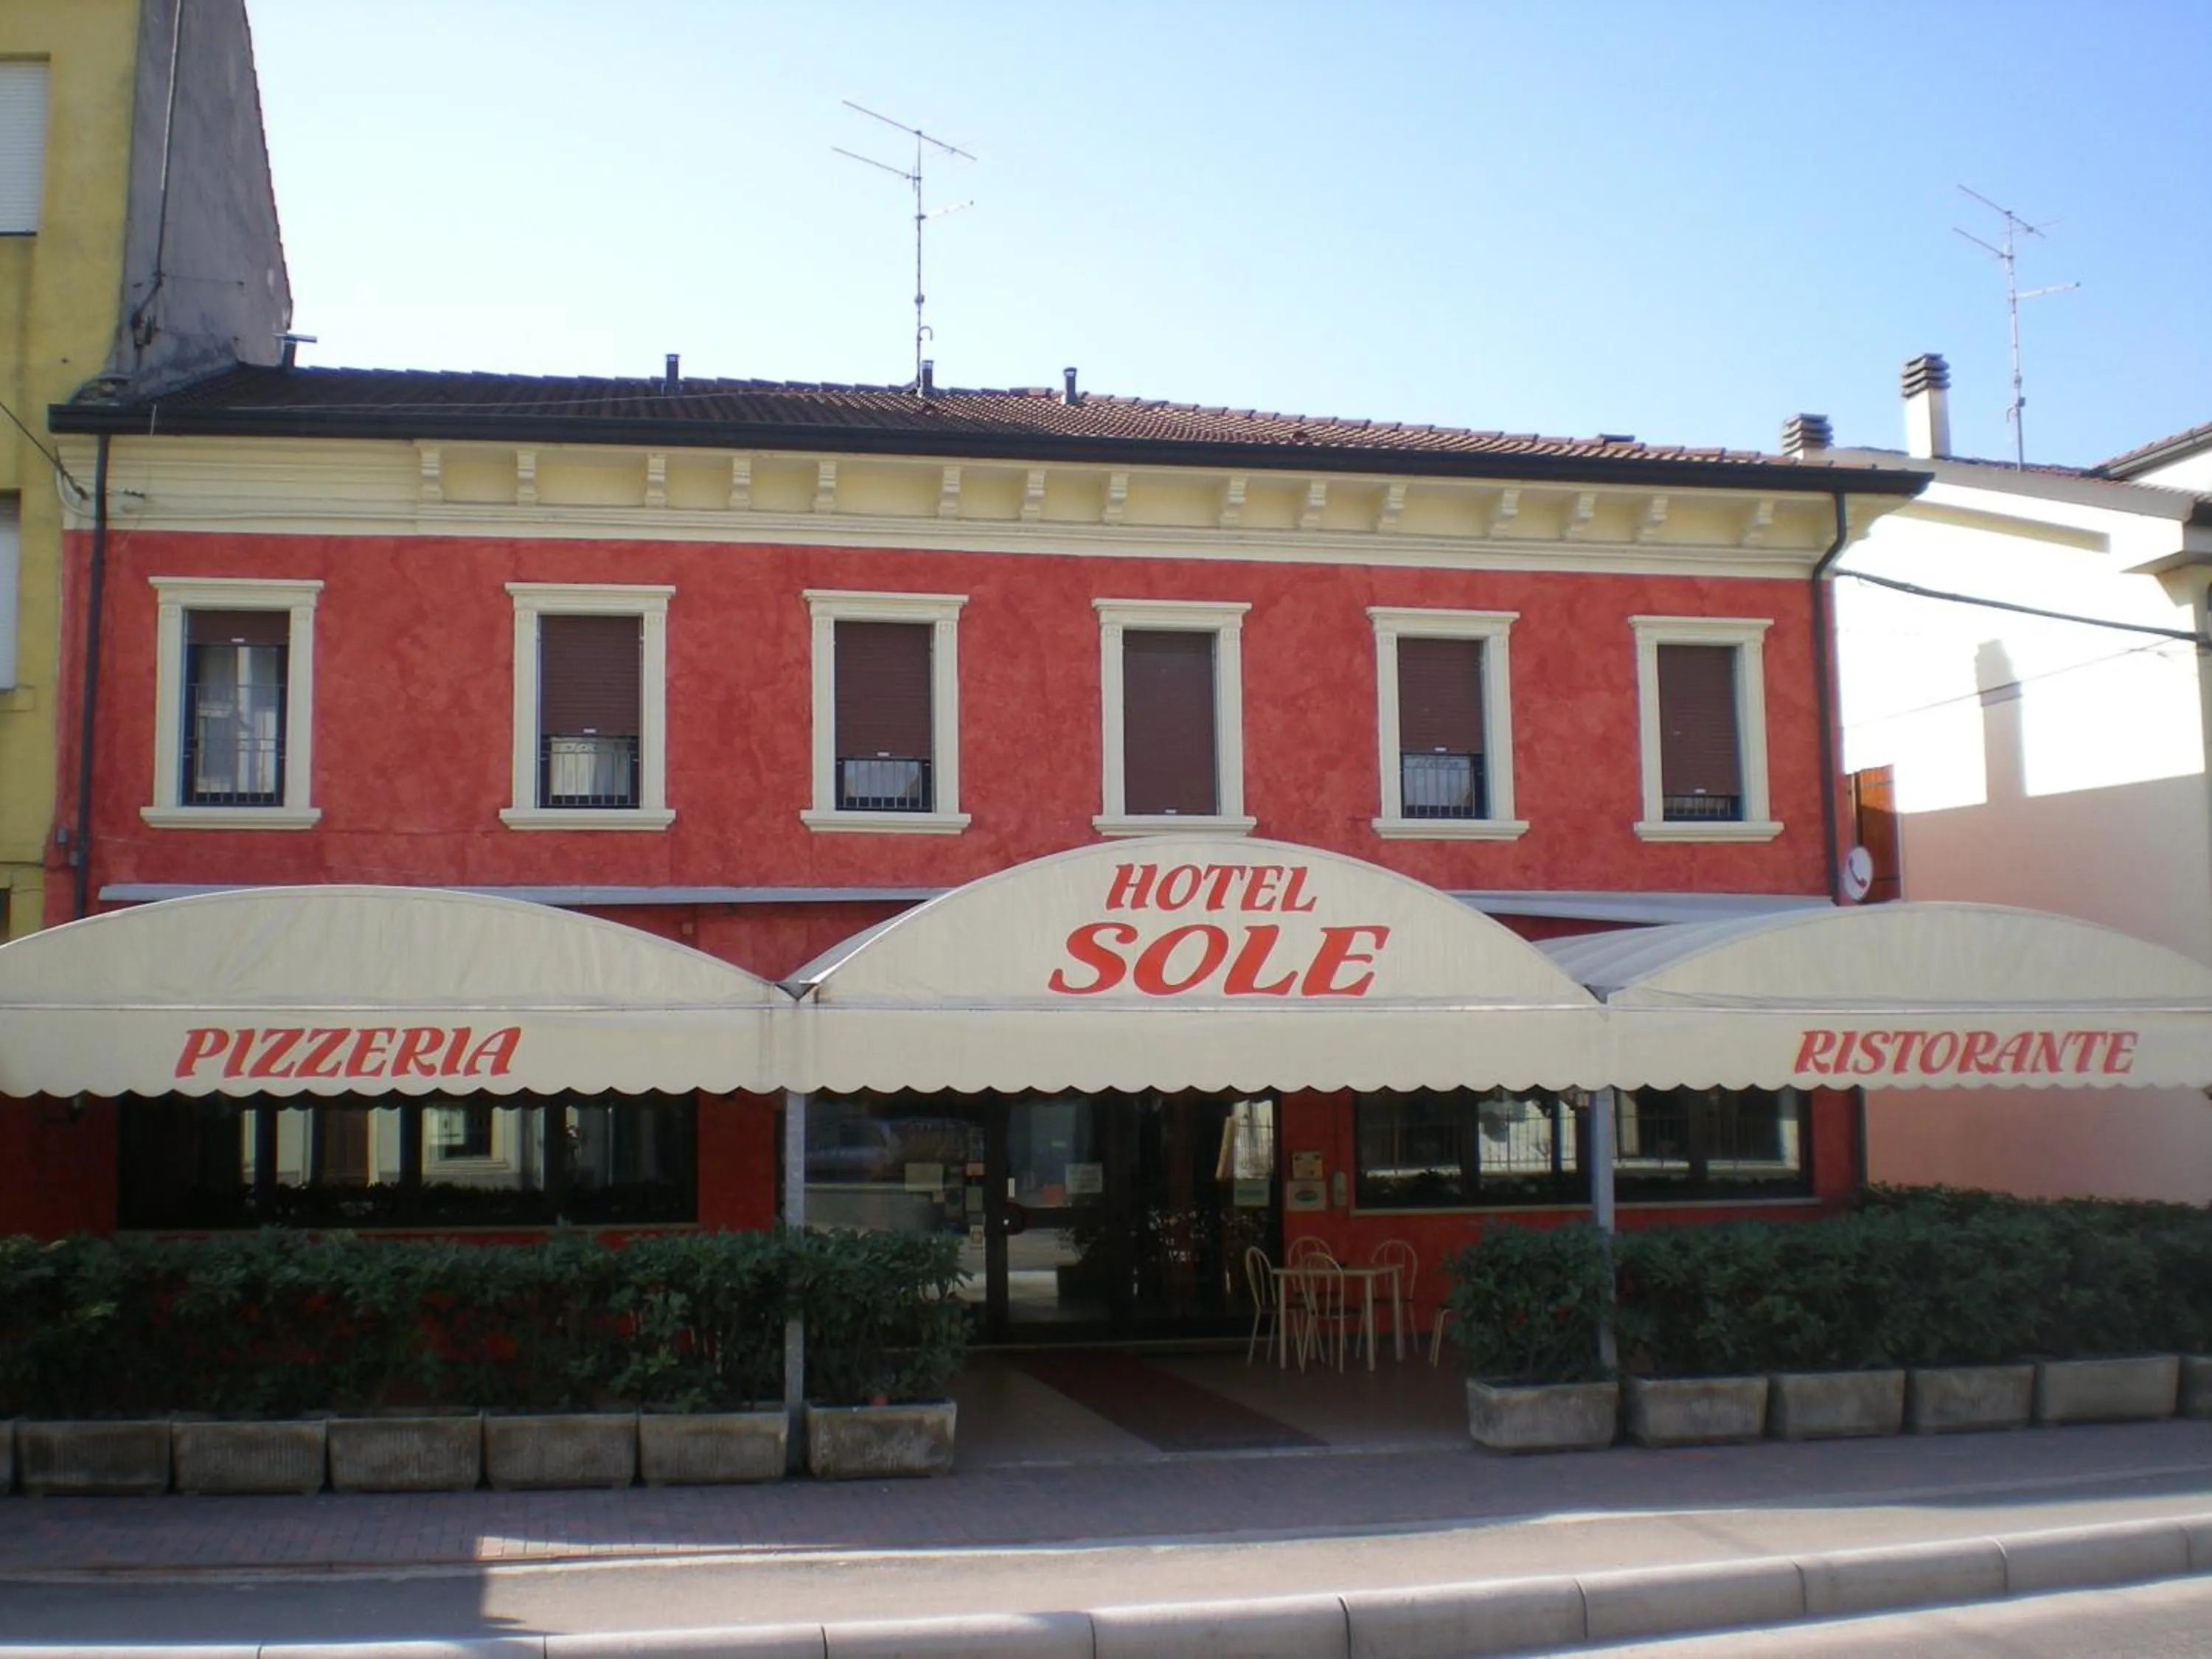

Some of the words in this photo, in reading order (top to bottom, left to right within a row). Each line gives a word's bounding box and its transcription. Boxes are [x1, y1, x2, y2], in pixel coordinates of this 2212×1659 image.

[1105, 863, 1317, 911] HOTEL
[1048, 922, 1391, 996] SOLE
[175, 1026, 521, 1079] PIZZERIA
[1793, 1031, 2138, 1076] RISTORANTE
